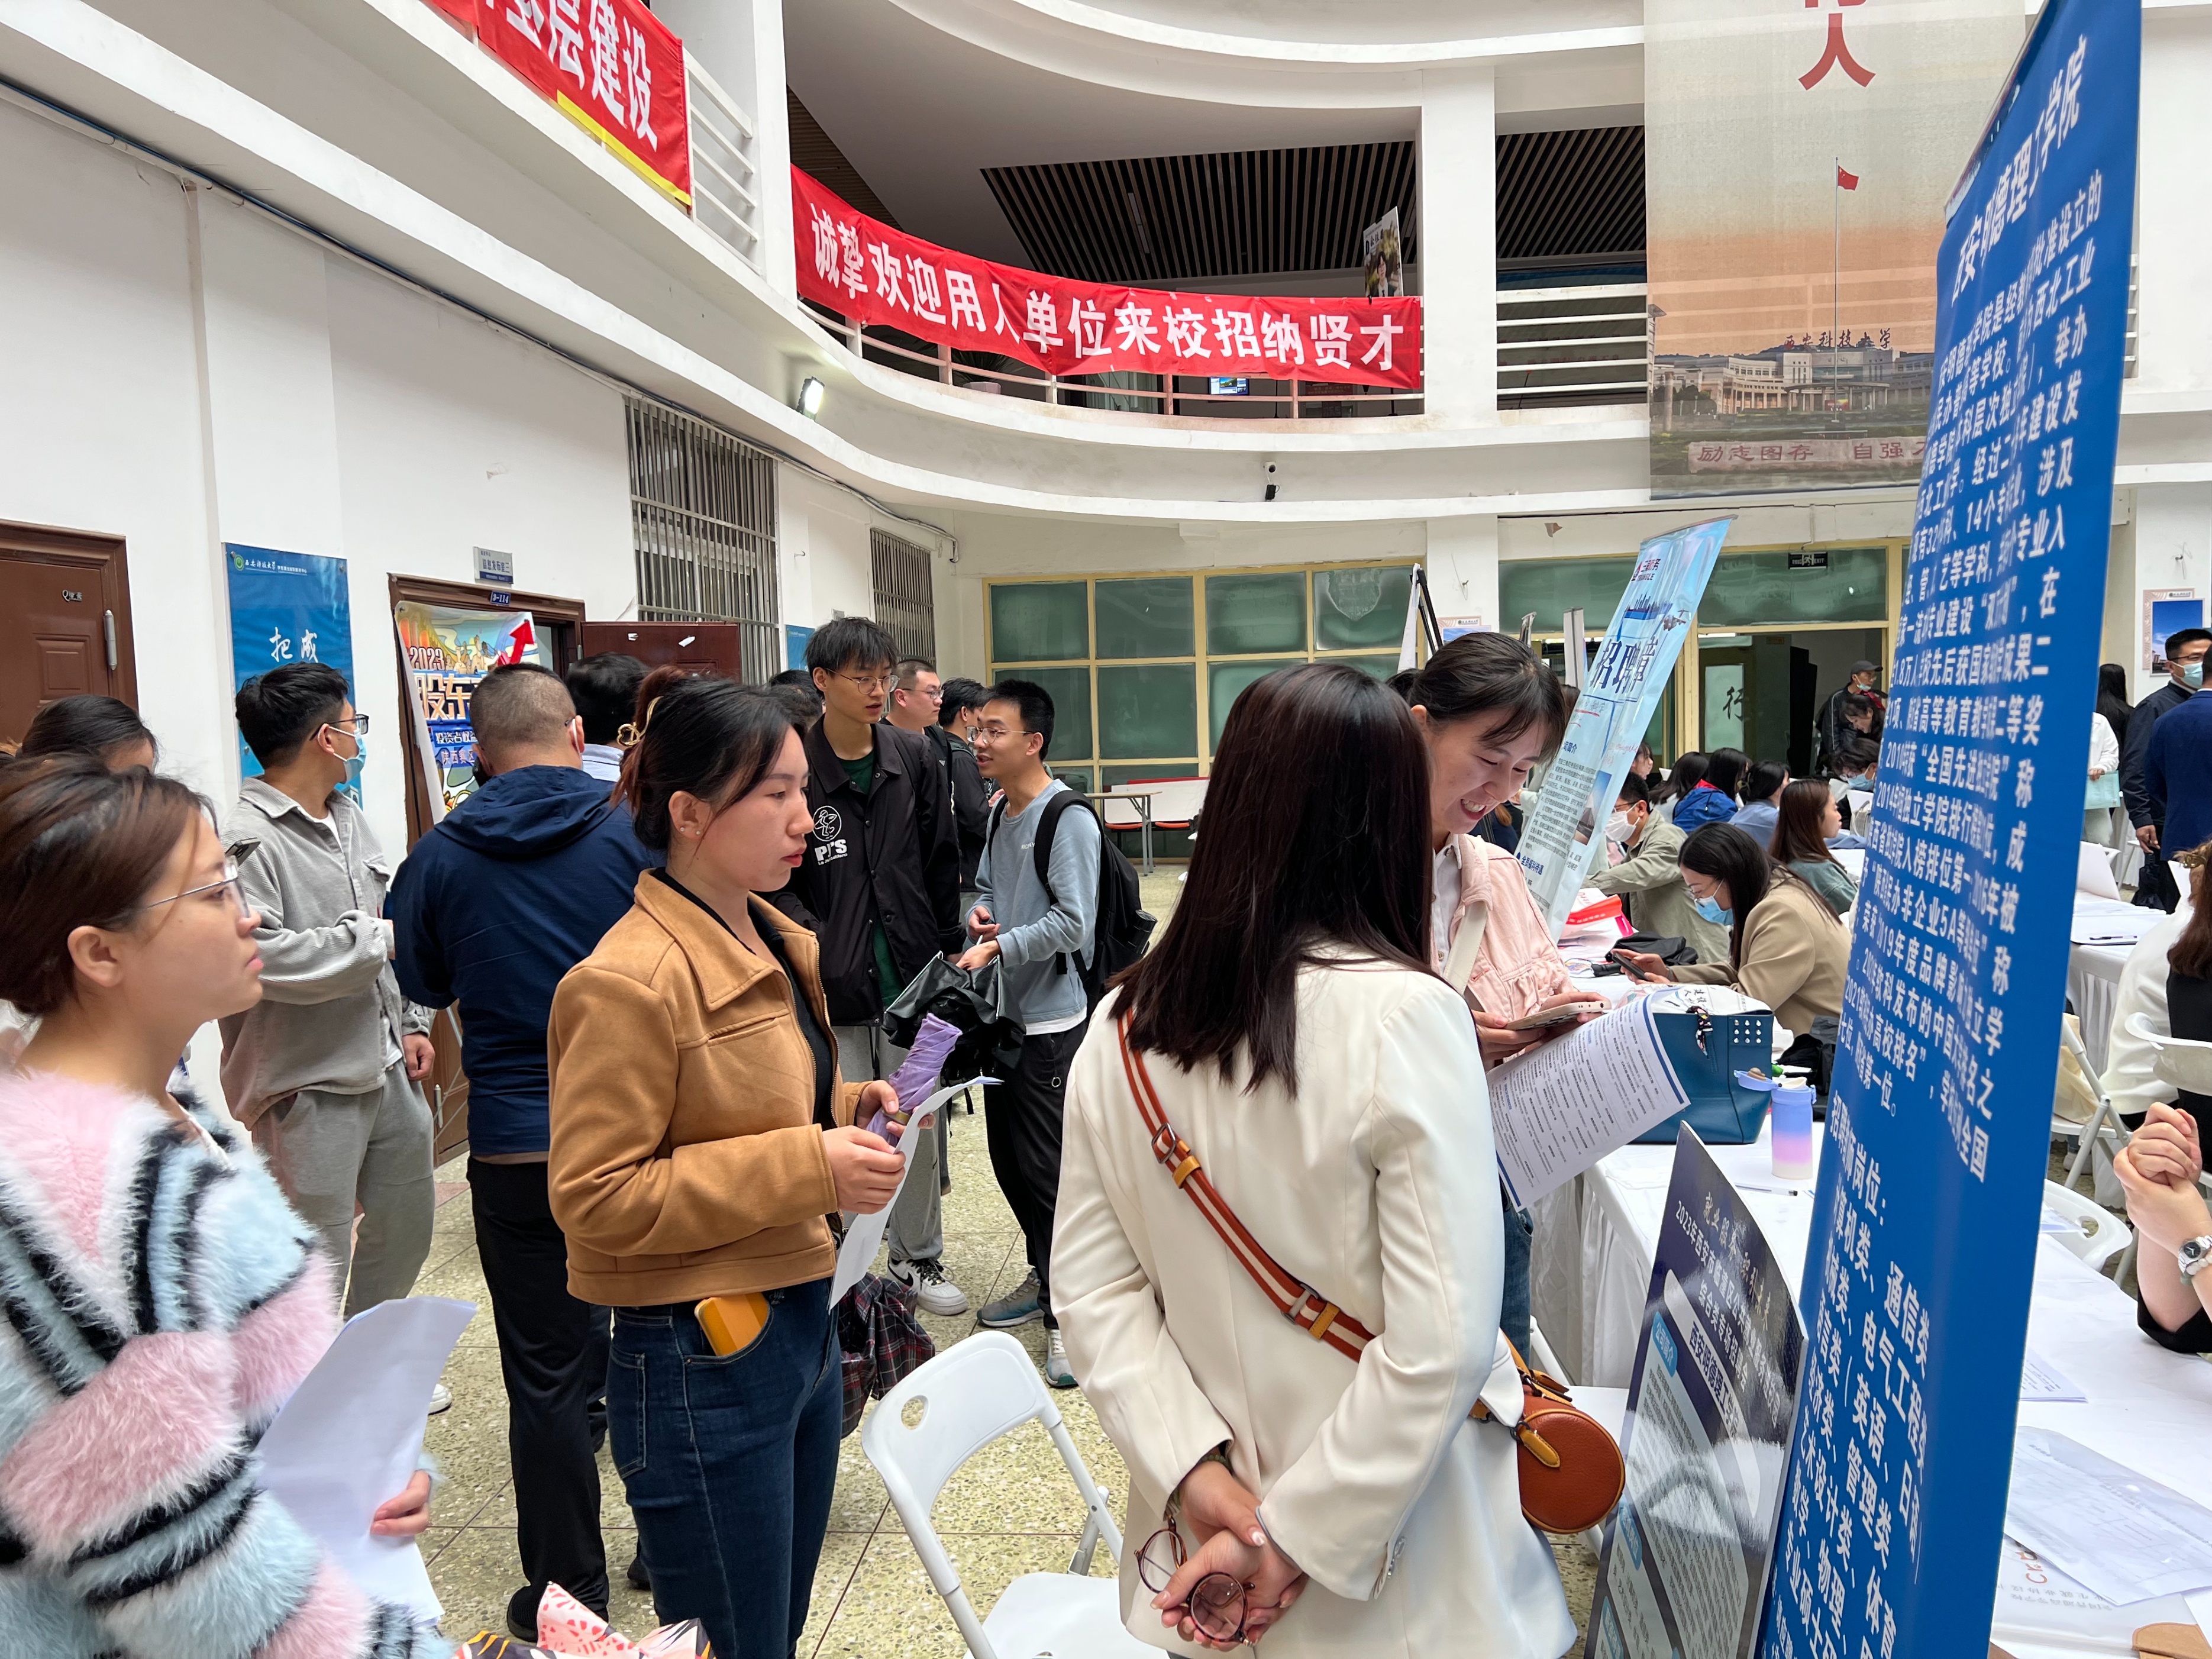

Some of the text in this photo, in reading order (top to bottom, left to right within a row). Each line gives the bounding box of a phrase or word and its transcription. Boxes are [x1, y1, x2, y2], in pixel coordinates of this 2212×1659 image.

[810, 204, 1405, 371] 诚挚欢迎用人单位来校招纳贤才
[1783, 327, 1892, 351] 西安科技大学
[492, 593, 509, 603] 3-114
[409, 647, 445, 670] 2023
[414, 673, 486, 721] 股东
